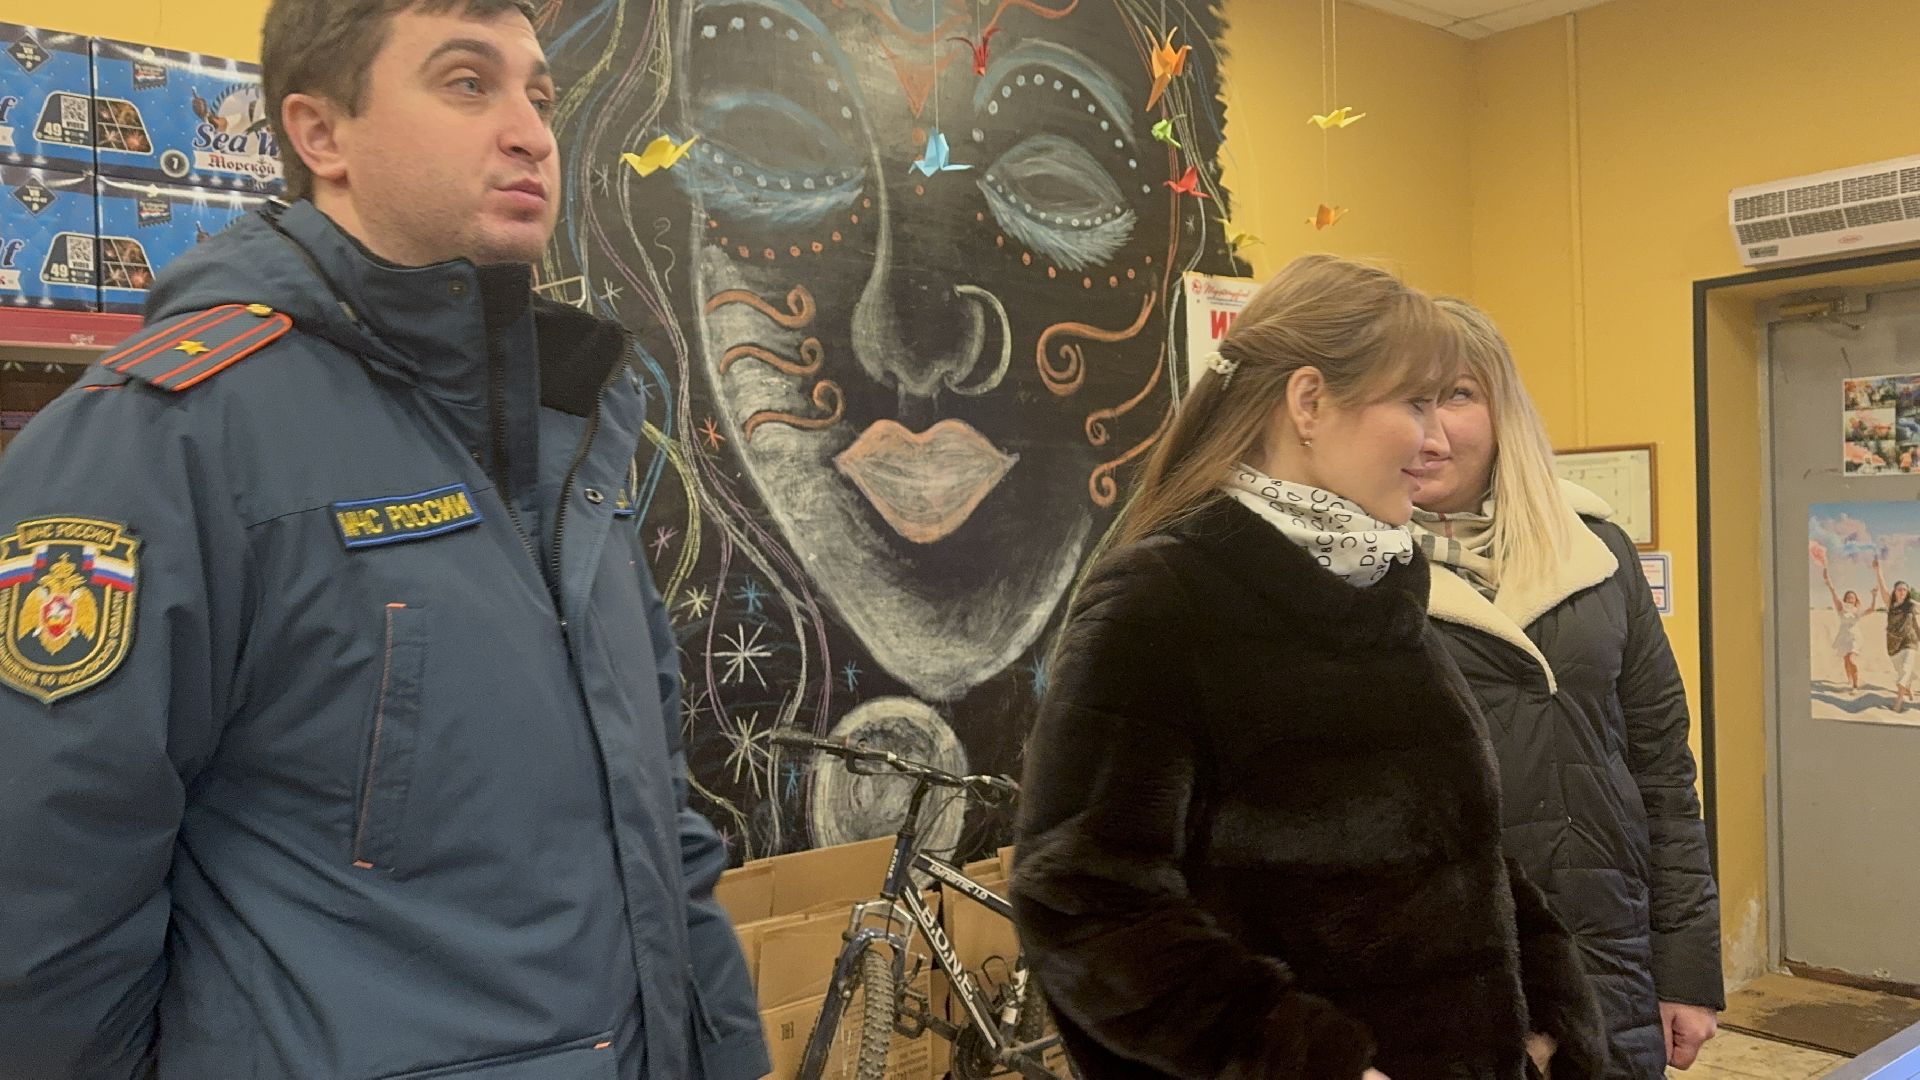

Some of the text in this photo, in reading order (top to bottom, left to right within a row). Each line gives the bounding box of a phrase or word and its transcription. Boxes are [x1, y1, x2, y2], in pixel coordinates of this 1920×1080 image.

[44, 122, 62, 136] 49
[193, 124, 247, 153] Sea
[207, 153, 276, 176] Морской
[51, 263, 69, 278] 49
[384, 491, 474, 531] РОССИИ
